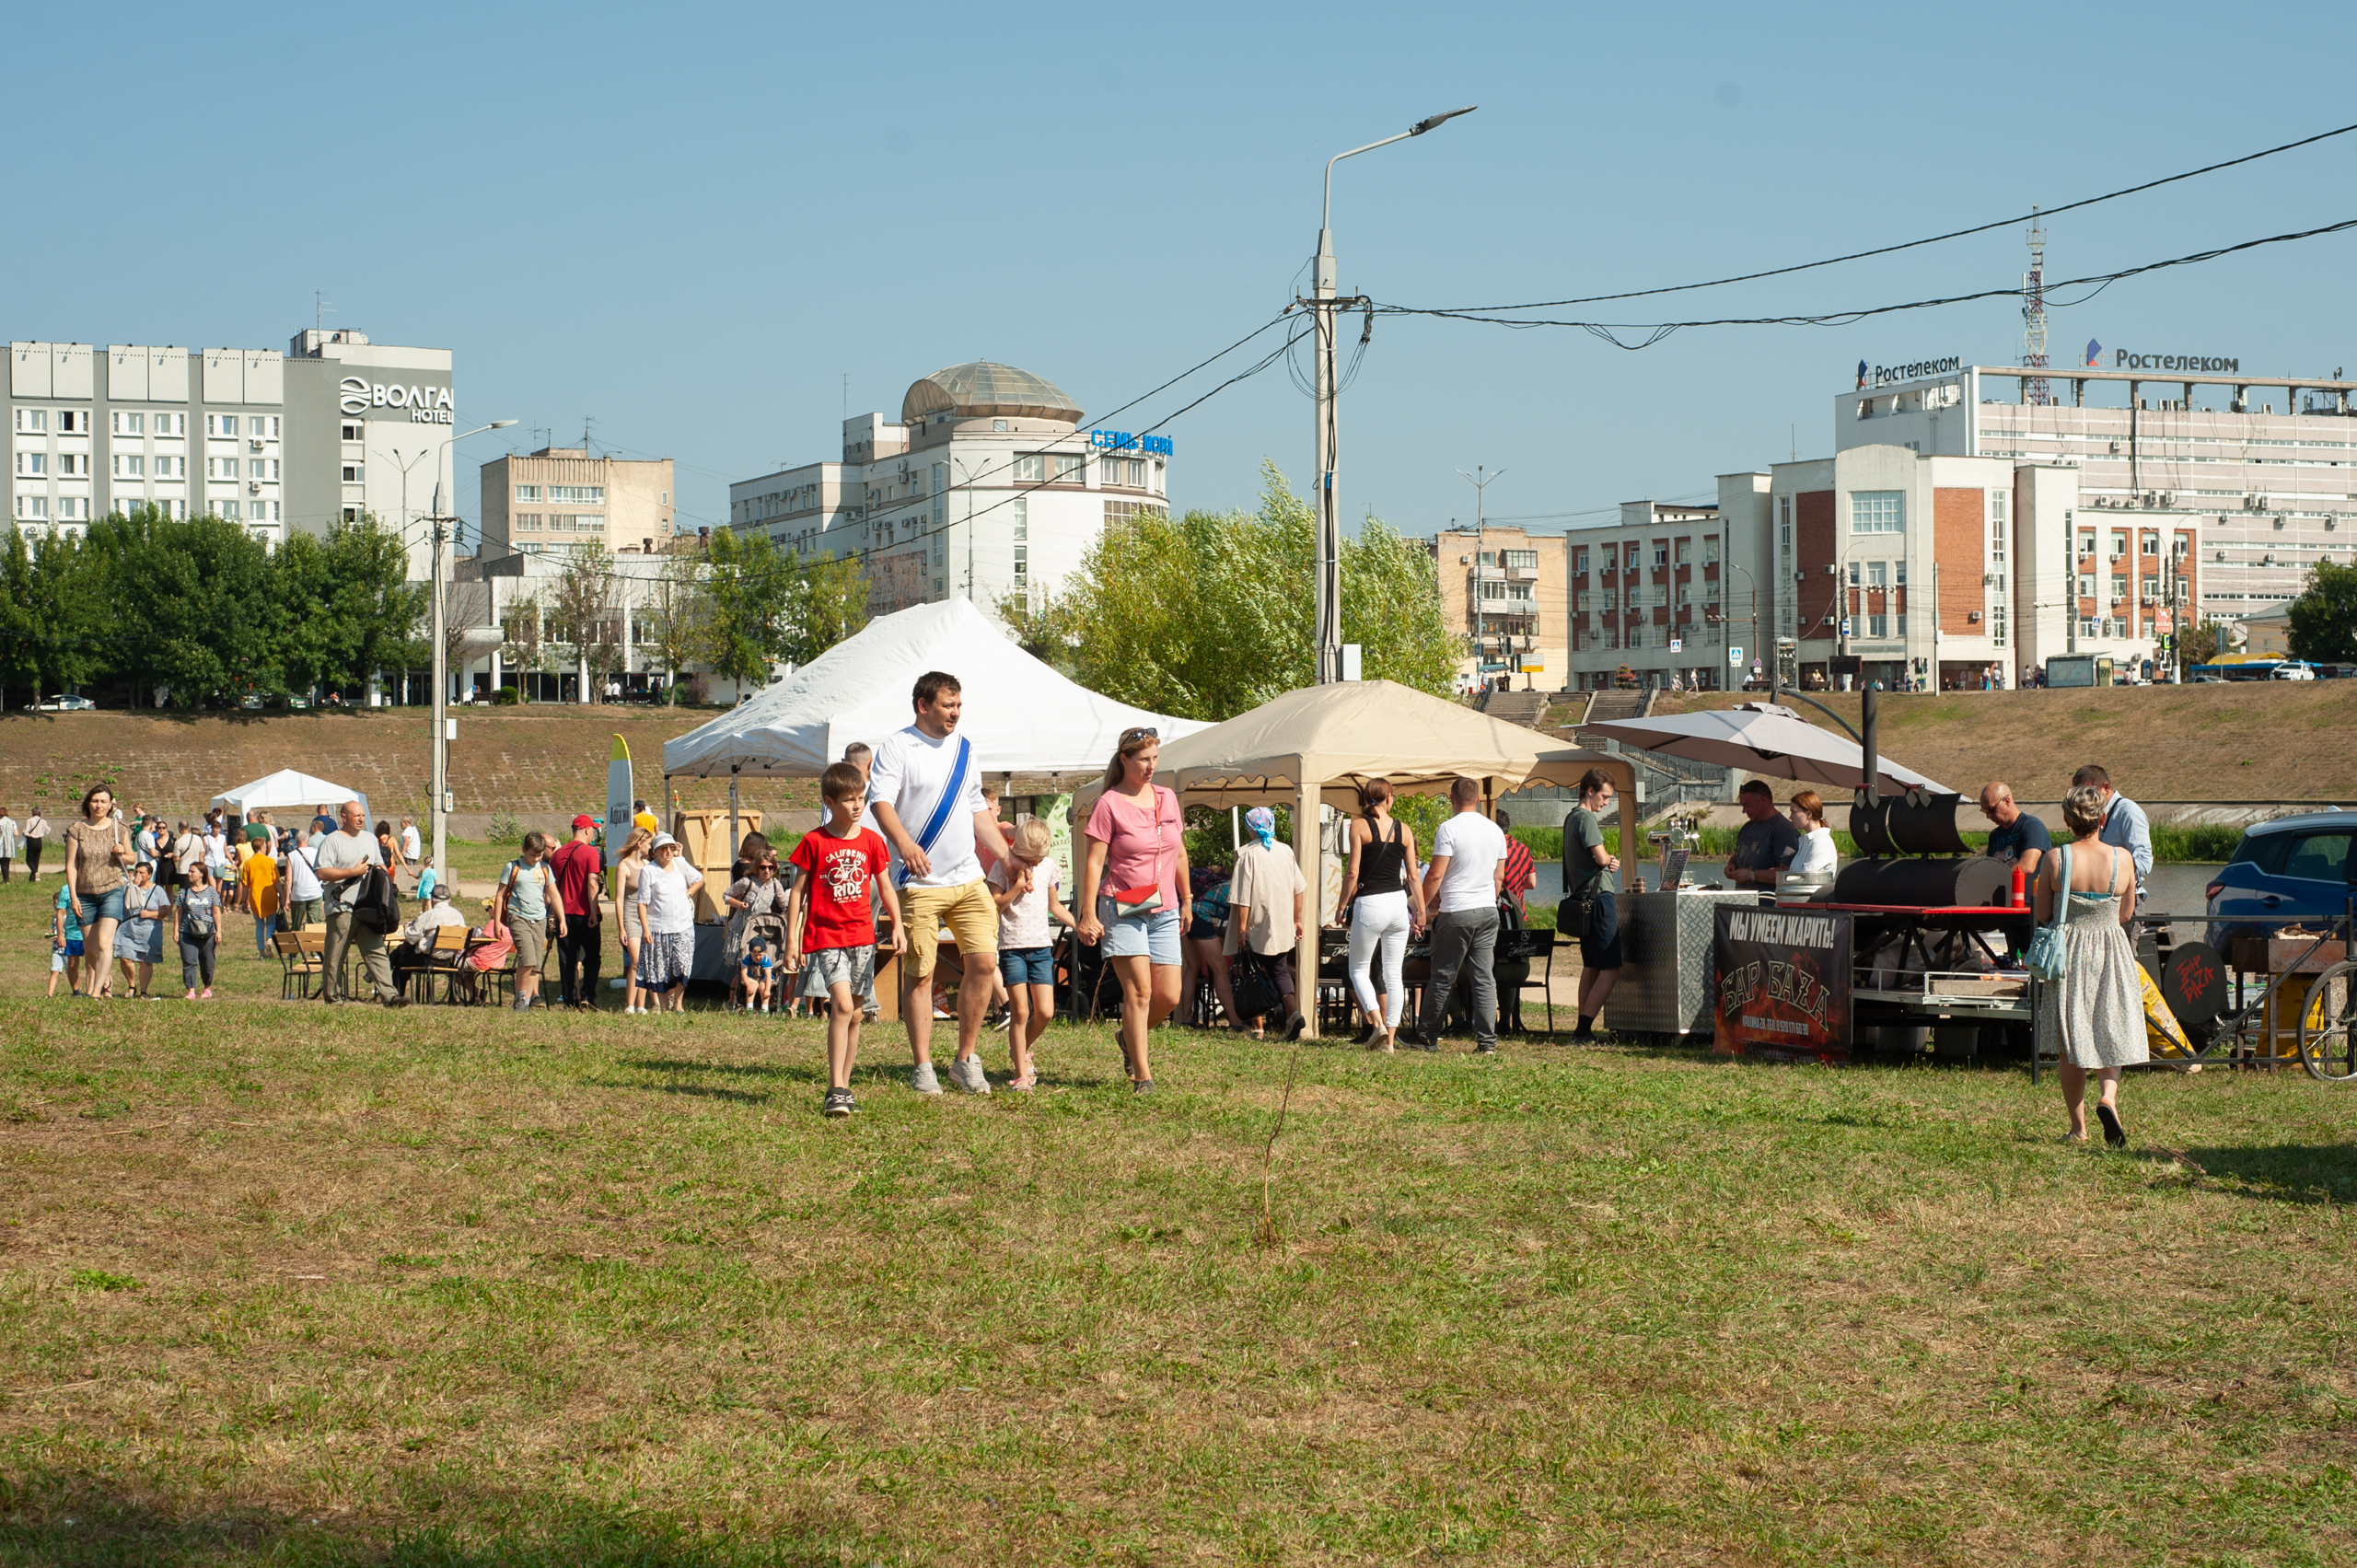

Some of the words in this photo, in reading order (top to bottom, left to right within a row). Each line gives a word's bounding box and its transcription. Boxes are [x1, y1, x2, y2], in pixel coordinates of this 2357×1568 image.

[1875, 356, 1959, 383] Ростелеком
[2117, 349, 2239, 372] Ростелеком
[372, 384, 454, 411] ВОЛГА
[411, 409, 454, 424] HOTEL
[1091, 429, 1138, 450] СЕМЬ
[825, 849, 867, 864] CALIFORNIA
[833, 882, 863, 898] RIDE
[188, 897, 209, 906] FILA
[1730, 912, 1750, 941] МЫ
[1750, 912, 1786, 945] УМЕЕМ
[1784, 915, 1837, 949] ЖАРИТЬ!
[1721, 960, 1760, 1017] БАР
